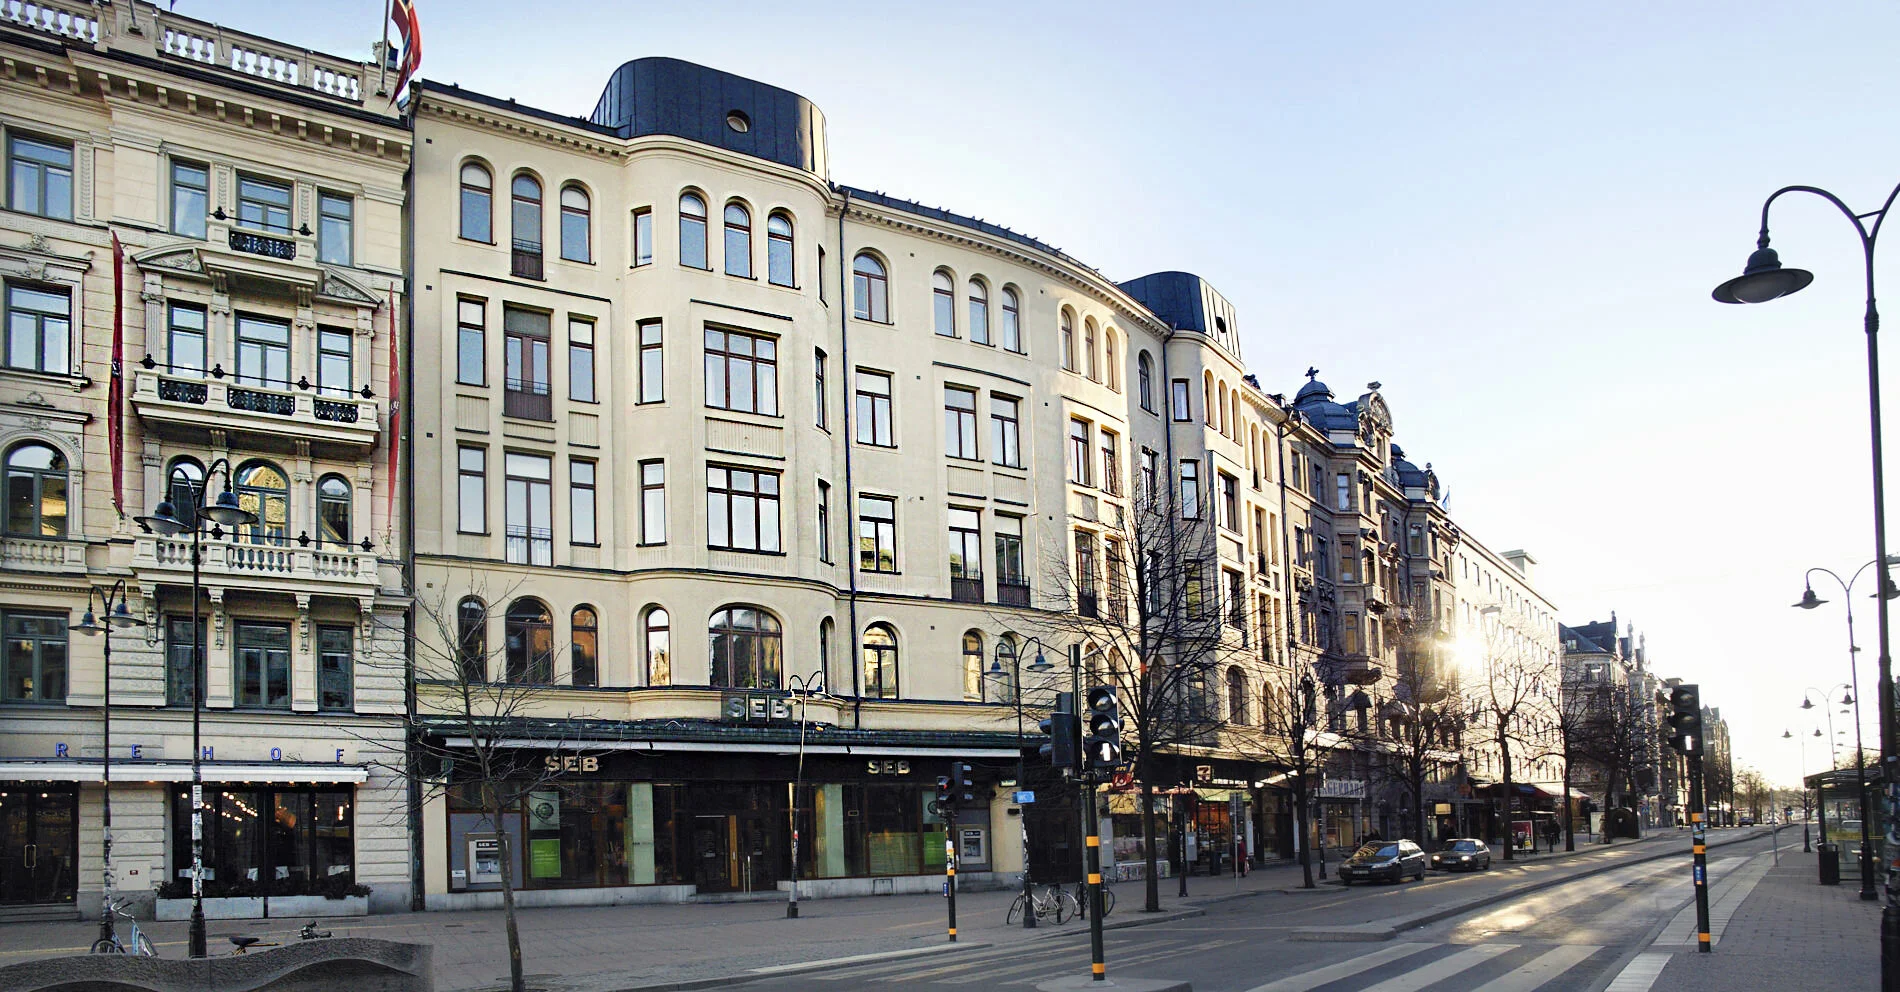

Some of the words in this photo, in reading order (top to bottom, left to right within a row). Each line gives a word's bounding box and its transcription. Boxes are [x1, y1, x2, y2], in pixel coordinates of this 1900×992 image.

[727, 696, 789, 719] SEB
[545, 756, 599, 772] SEB
[868, 760, 911, 774] SEB
